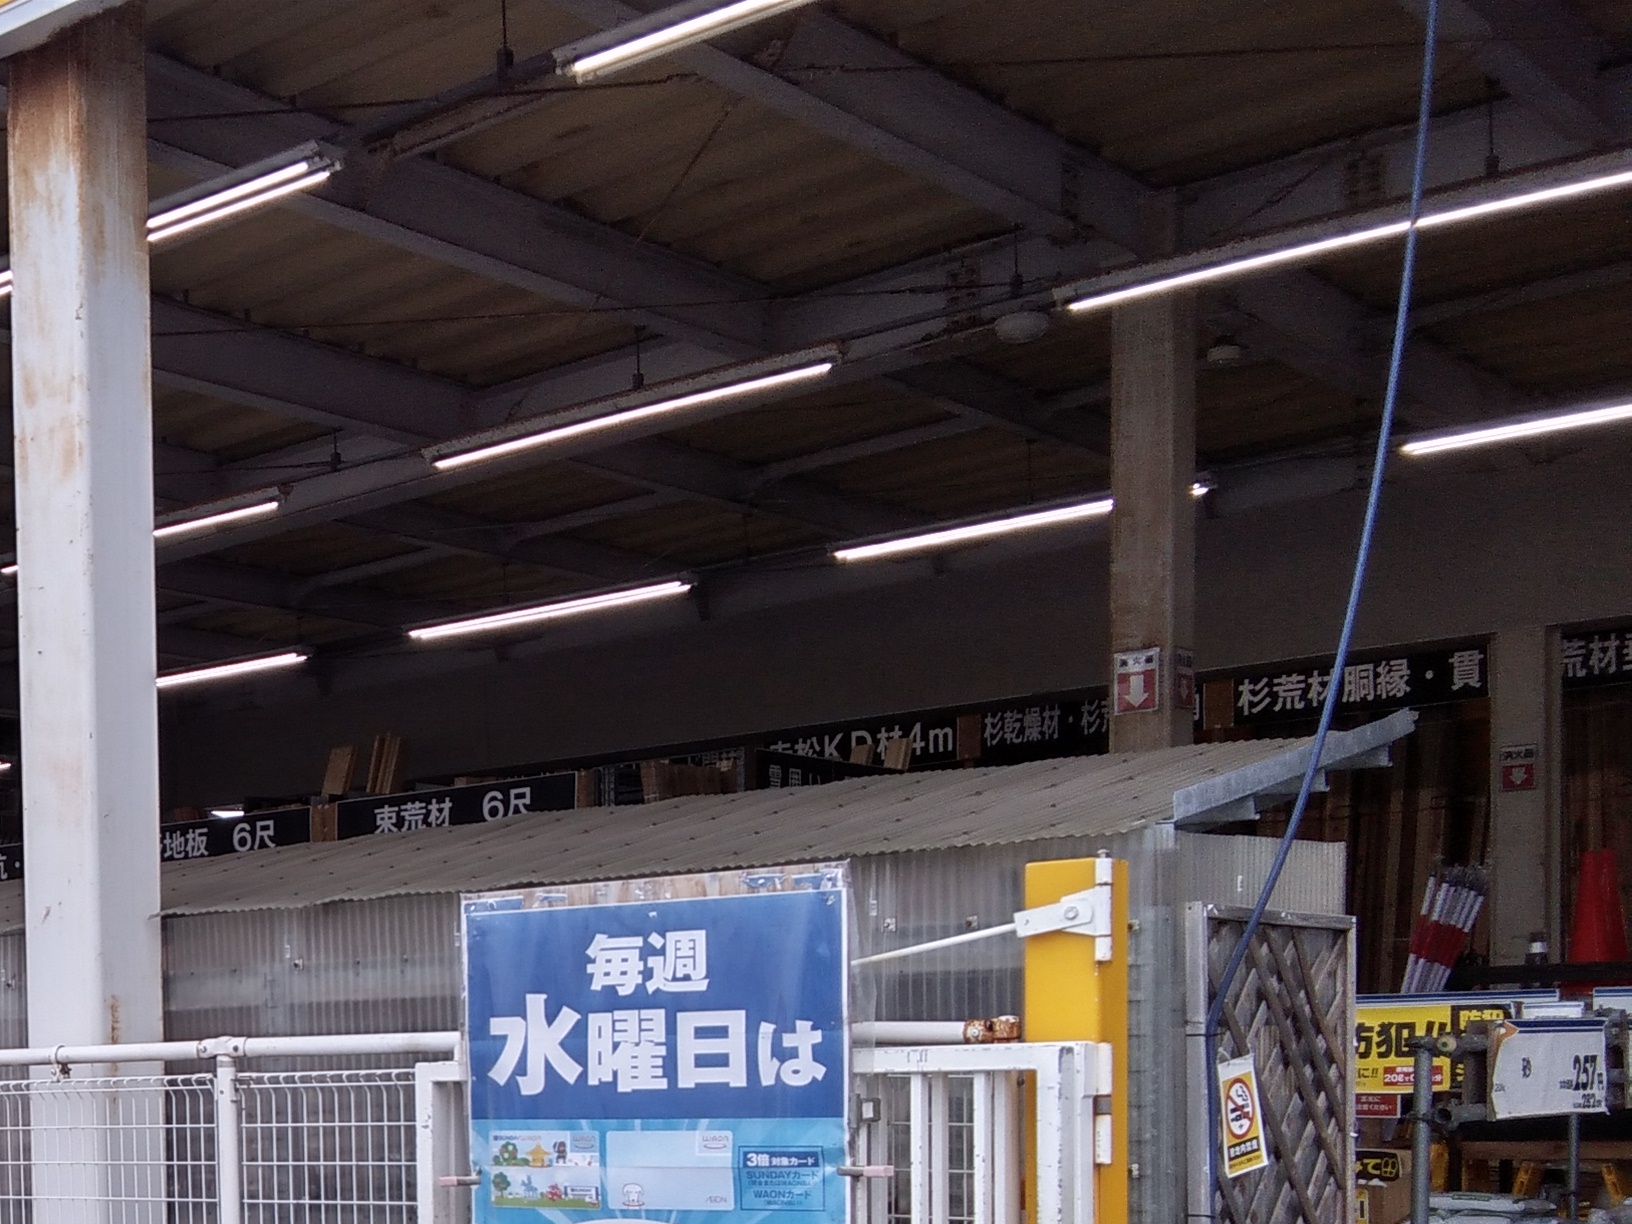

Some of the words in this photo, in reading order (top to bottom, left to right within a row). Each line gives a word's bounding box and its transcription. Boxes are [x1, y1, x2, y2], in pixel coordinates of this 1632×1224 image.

[481, 786, 532, 822] 6尺
[159, 827, 209, 859] 地板
[232, 819, 277, 853] 6尺
[585, 929, 709, 996] 毎週
[487, 993, 828, 1096] 水曜日は
[746, 1153, 770, 1167] 3倍
[746, 1170, 819, 1180] SUNDAYカード
[753, 1190, 812, 1200] WAONカード
